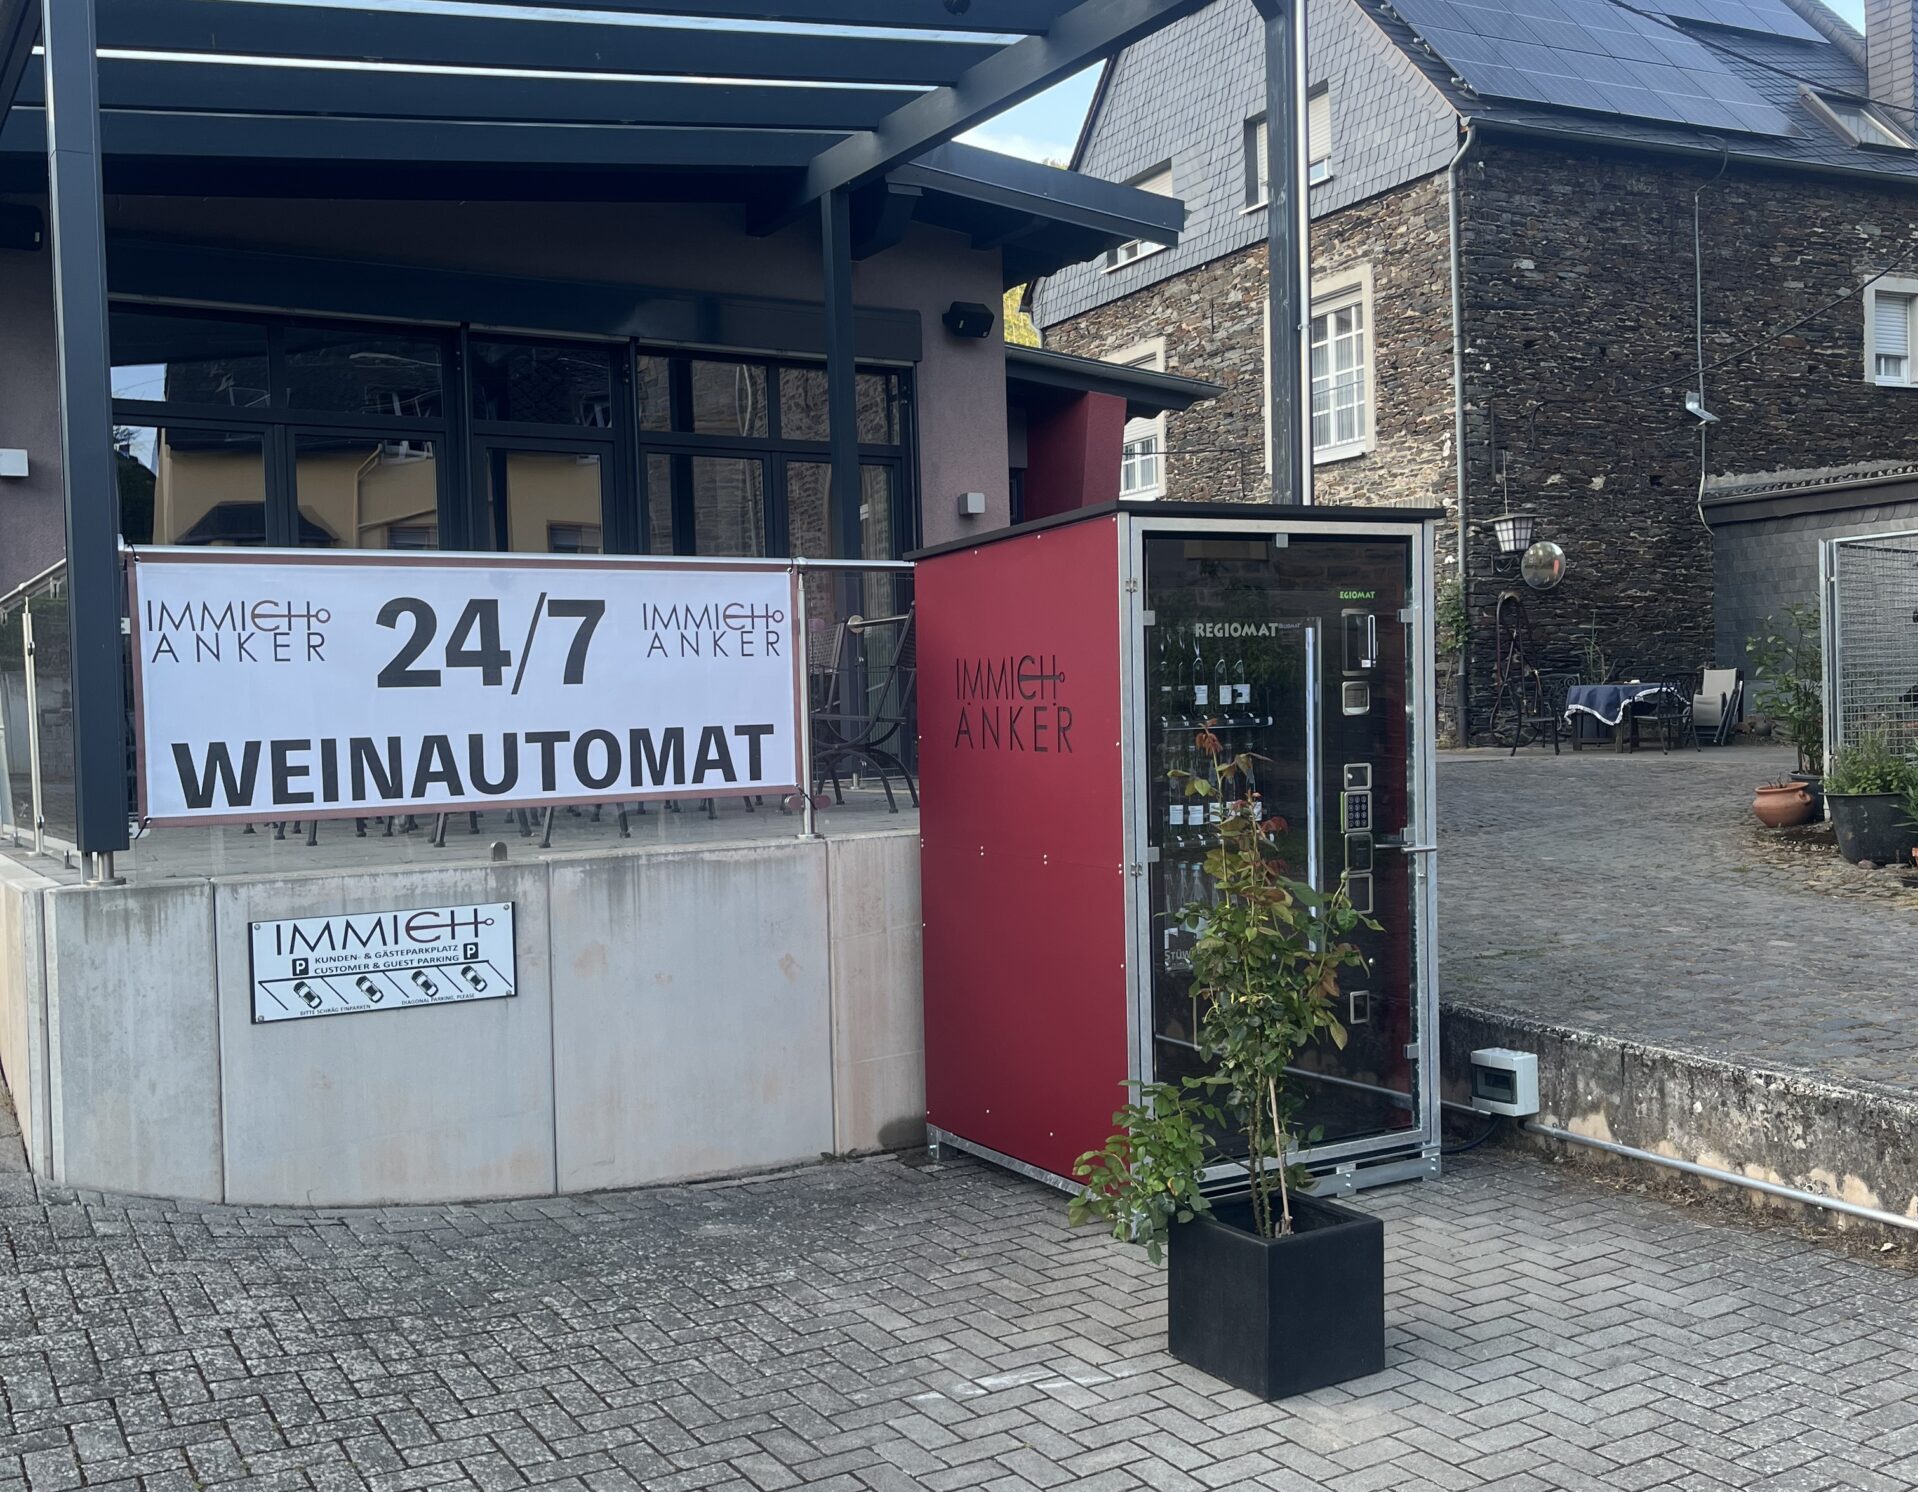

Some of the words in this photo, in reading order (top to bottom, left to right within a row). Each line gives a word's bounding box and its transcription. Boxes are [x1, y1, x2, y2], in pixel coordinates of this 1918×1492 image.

[147, 600, 331, 632] IMMICH
[643, 602, 784, 631] IMMICH
[1195, 622, 1278, 638] REGIOMAT
[152, 632, 325, 663] ANKER
[376, 592, 606, 695] 24/7
[647, 630, 780, 658] ANKER
[957, 655, 1065, 700] IMMICH
[955, 705, 1072, 753] ANKER
[171, 724, 774, 809] WEINAUTOMAT
[276, 908, 494, 956] IMMICH
[314, 963, 370, 974] CUSTOMER
[372, 961, 380, 969] &
[383, 959, 416, 968] GUEST
[417, 955, 460, 964] PARKING
[364, 952, 372, 960] &
[374, 944, 459, 959] GÄSTEPARKPLATZ
[465, 944, 477, 959] P
[295, 959, 306, 975] P
